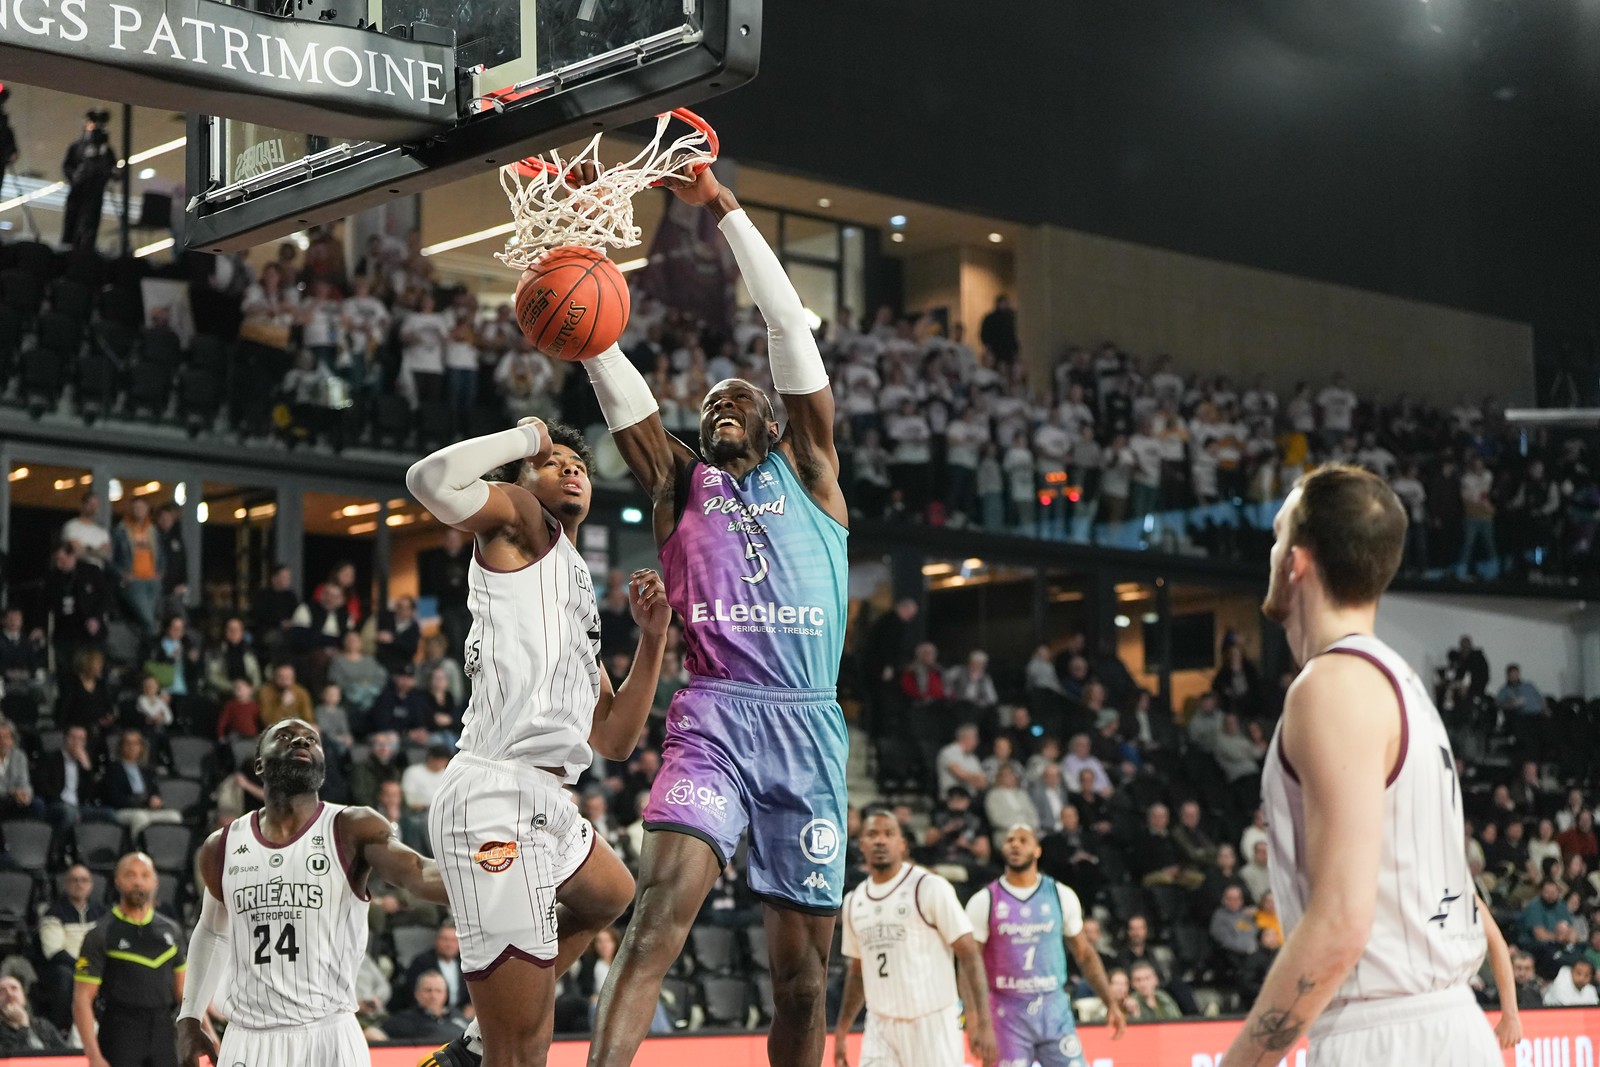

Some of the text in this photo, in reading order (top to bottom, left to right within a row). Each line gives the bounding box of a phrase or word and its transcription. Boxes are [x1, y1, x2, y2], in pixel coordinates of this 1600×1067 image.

[109, 4, 446, 105] PATRIMOINE
[524, 288, 558, 336] LEGAC
[740, 542, 769, 585] 5
[691, 599, 825, 626] E.Leclerc
[731, 625, 777, 634] PERIGUEUX
[783, 626, 824, 637] TRELISSAC
[697, 787, 728, 810] gie
[233, 876, 323, 914] ORLÉANS
[254, 923, 300, 965] 24
[1022, 945, 1037, 971] 1
[877, 952, 889, 979] 2
